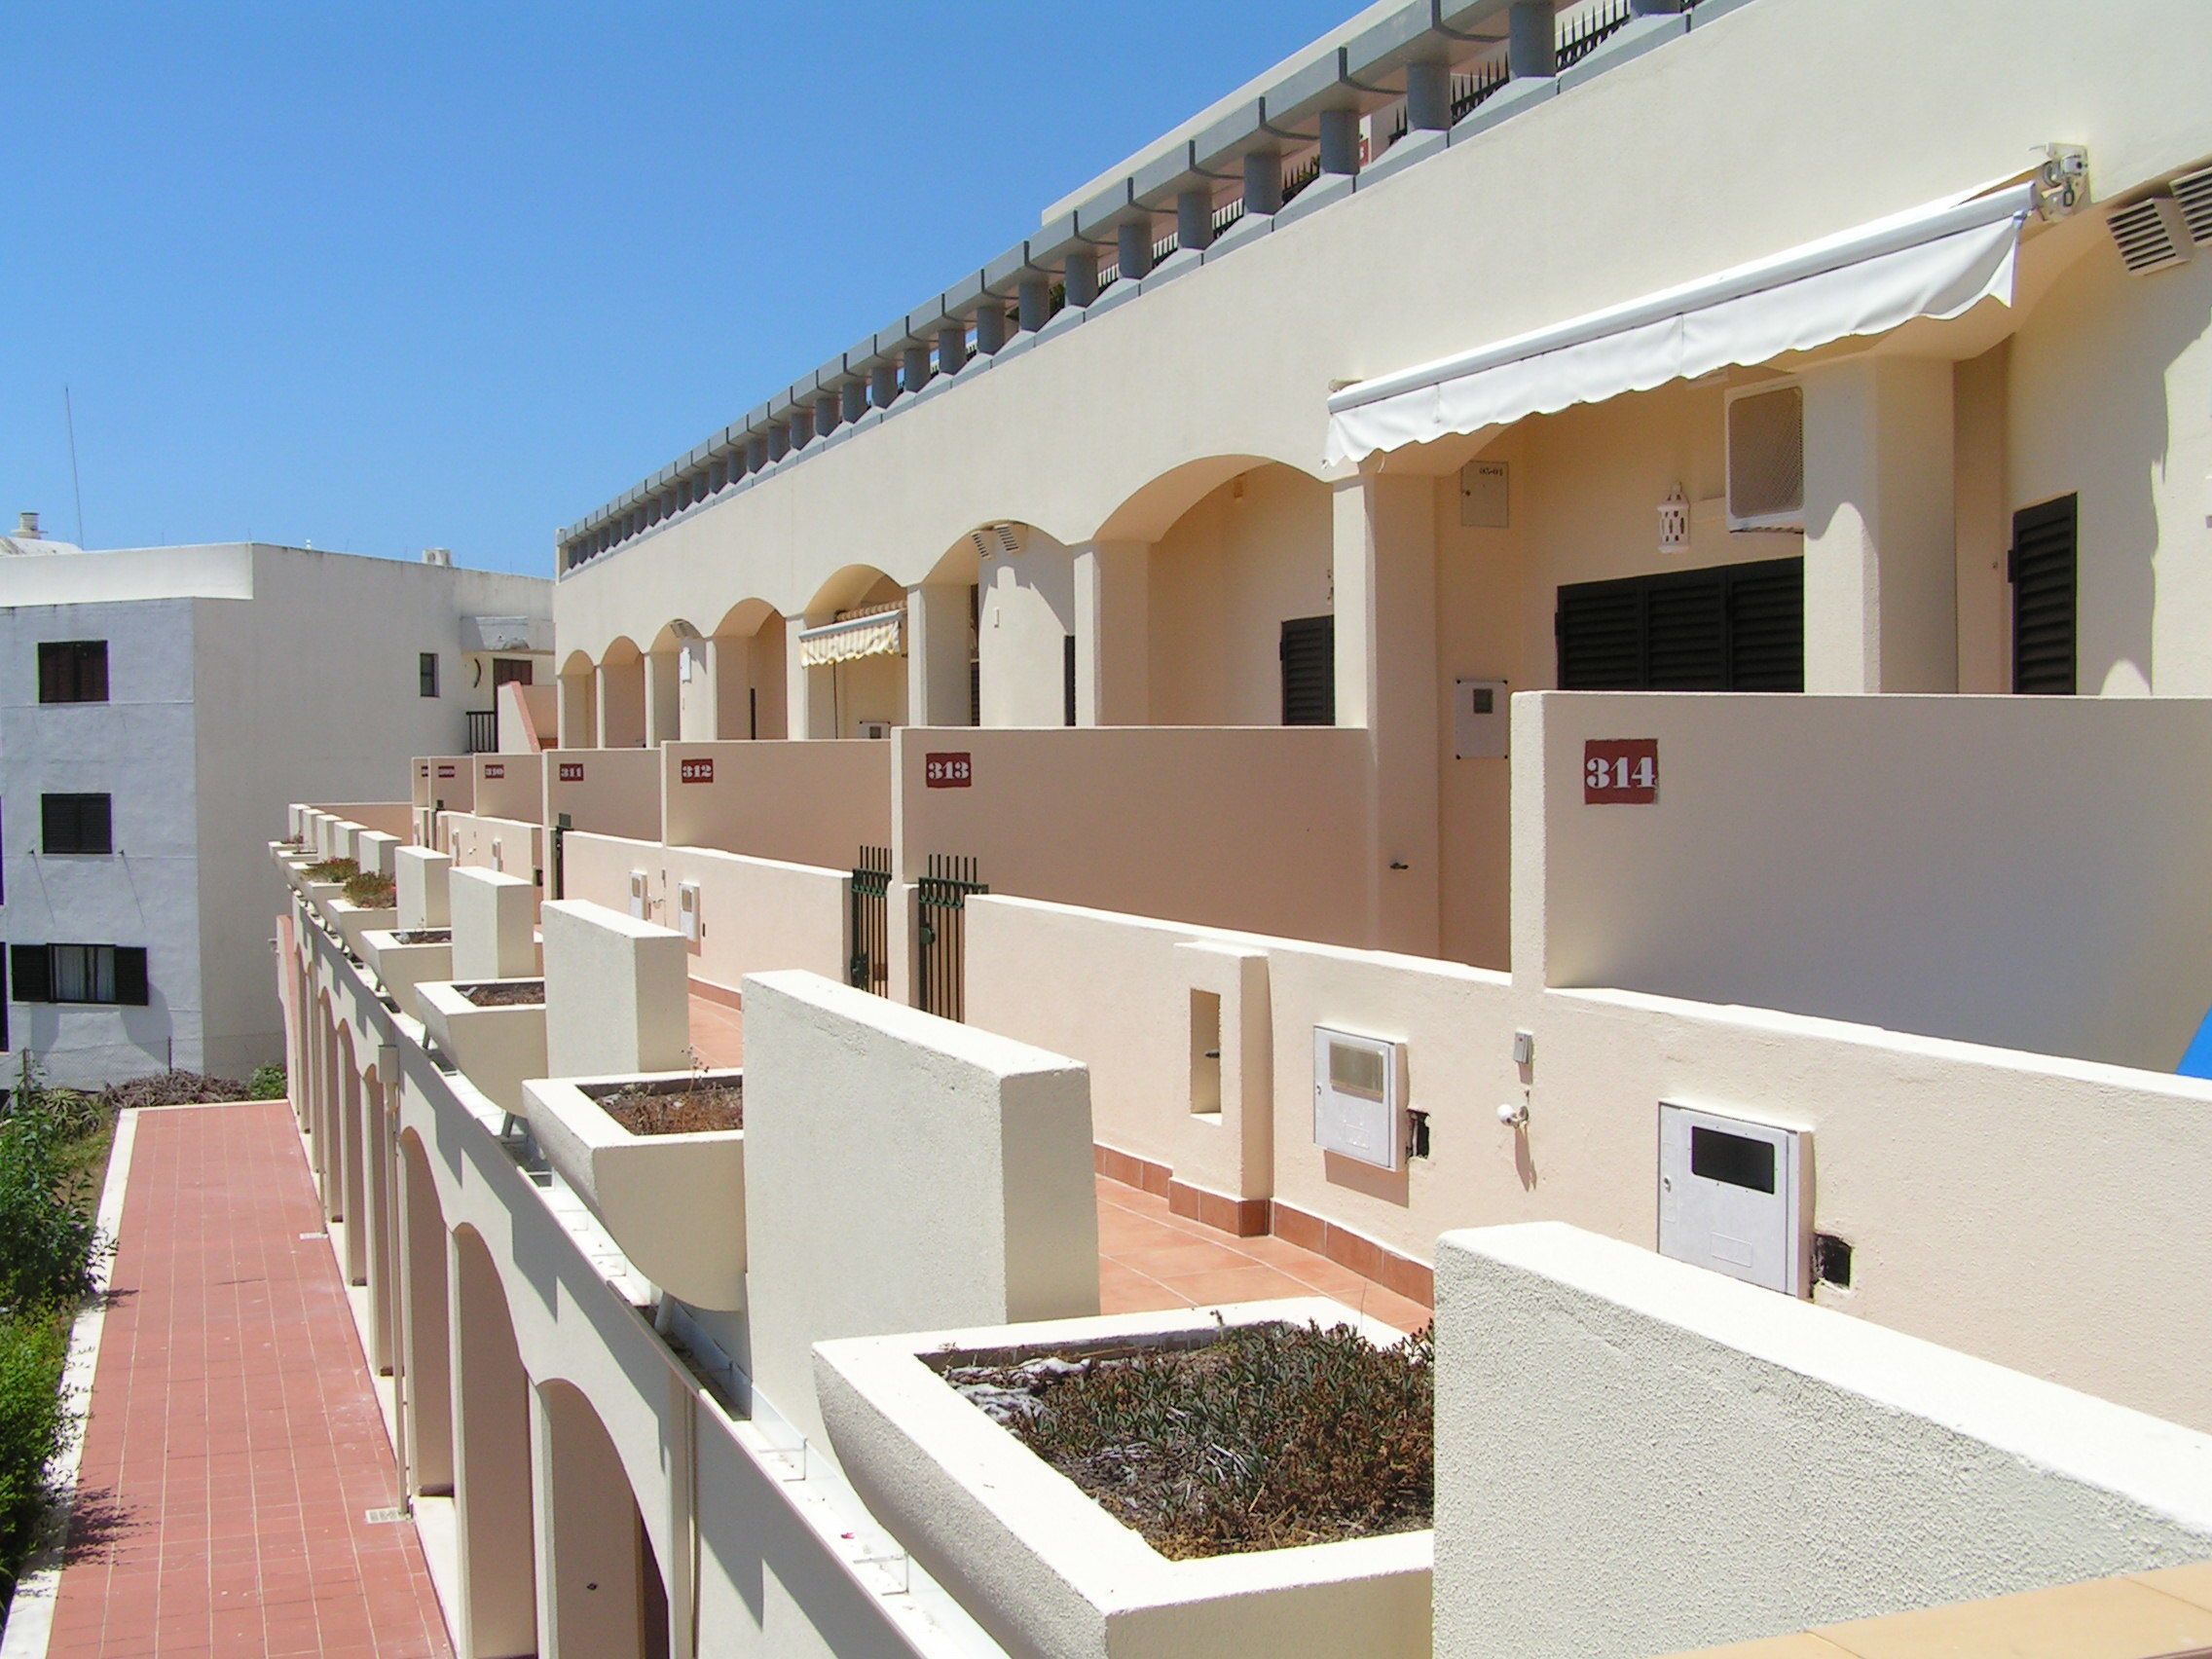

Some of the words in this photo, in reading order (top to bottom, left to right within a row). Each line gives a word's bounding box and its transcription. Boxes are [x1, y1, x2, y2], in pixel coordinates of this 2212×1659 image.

[561, 767, 582, 777] 311
[682, 765, 712, 778] 312
[928, 761, 970, 780] 313
[1586, 756, 1656, 789] 314
